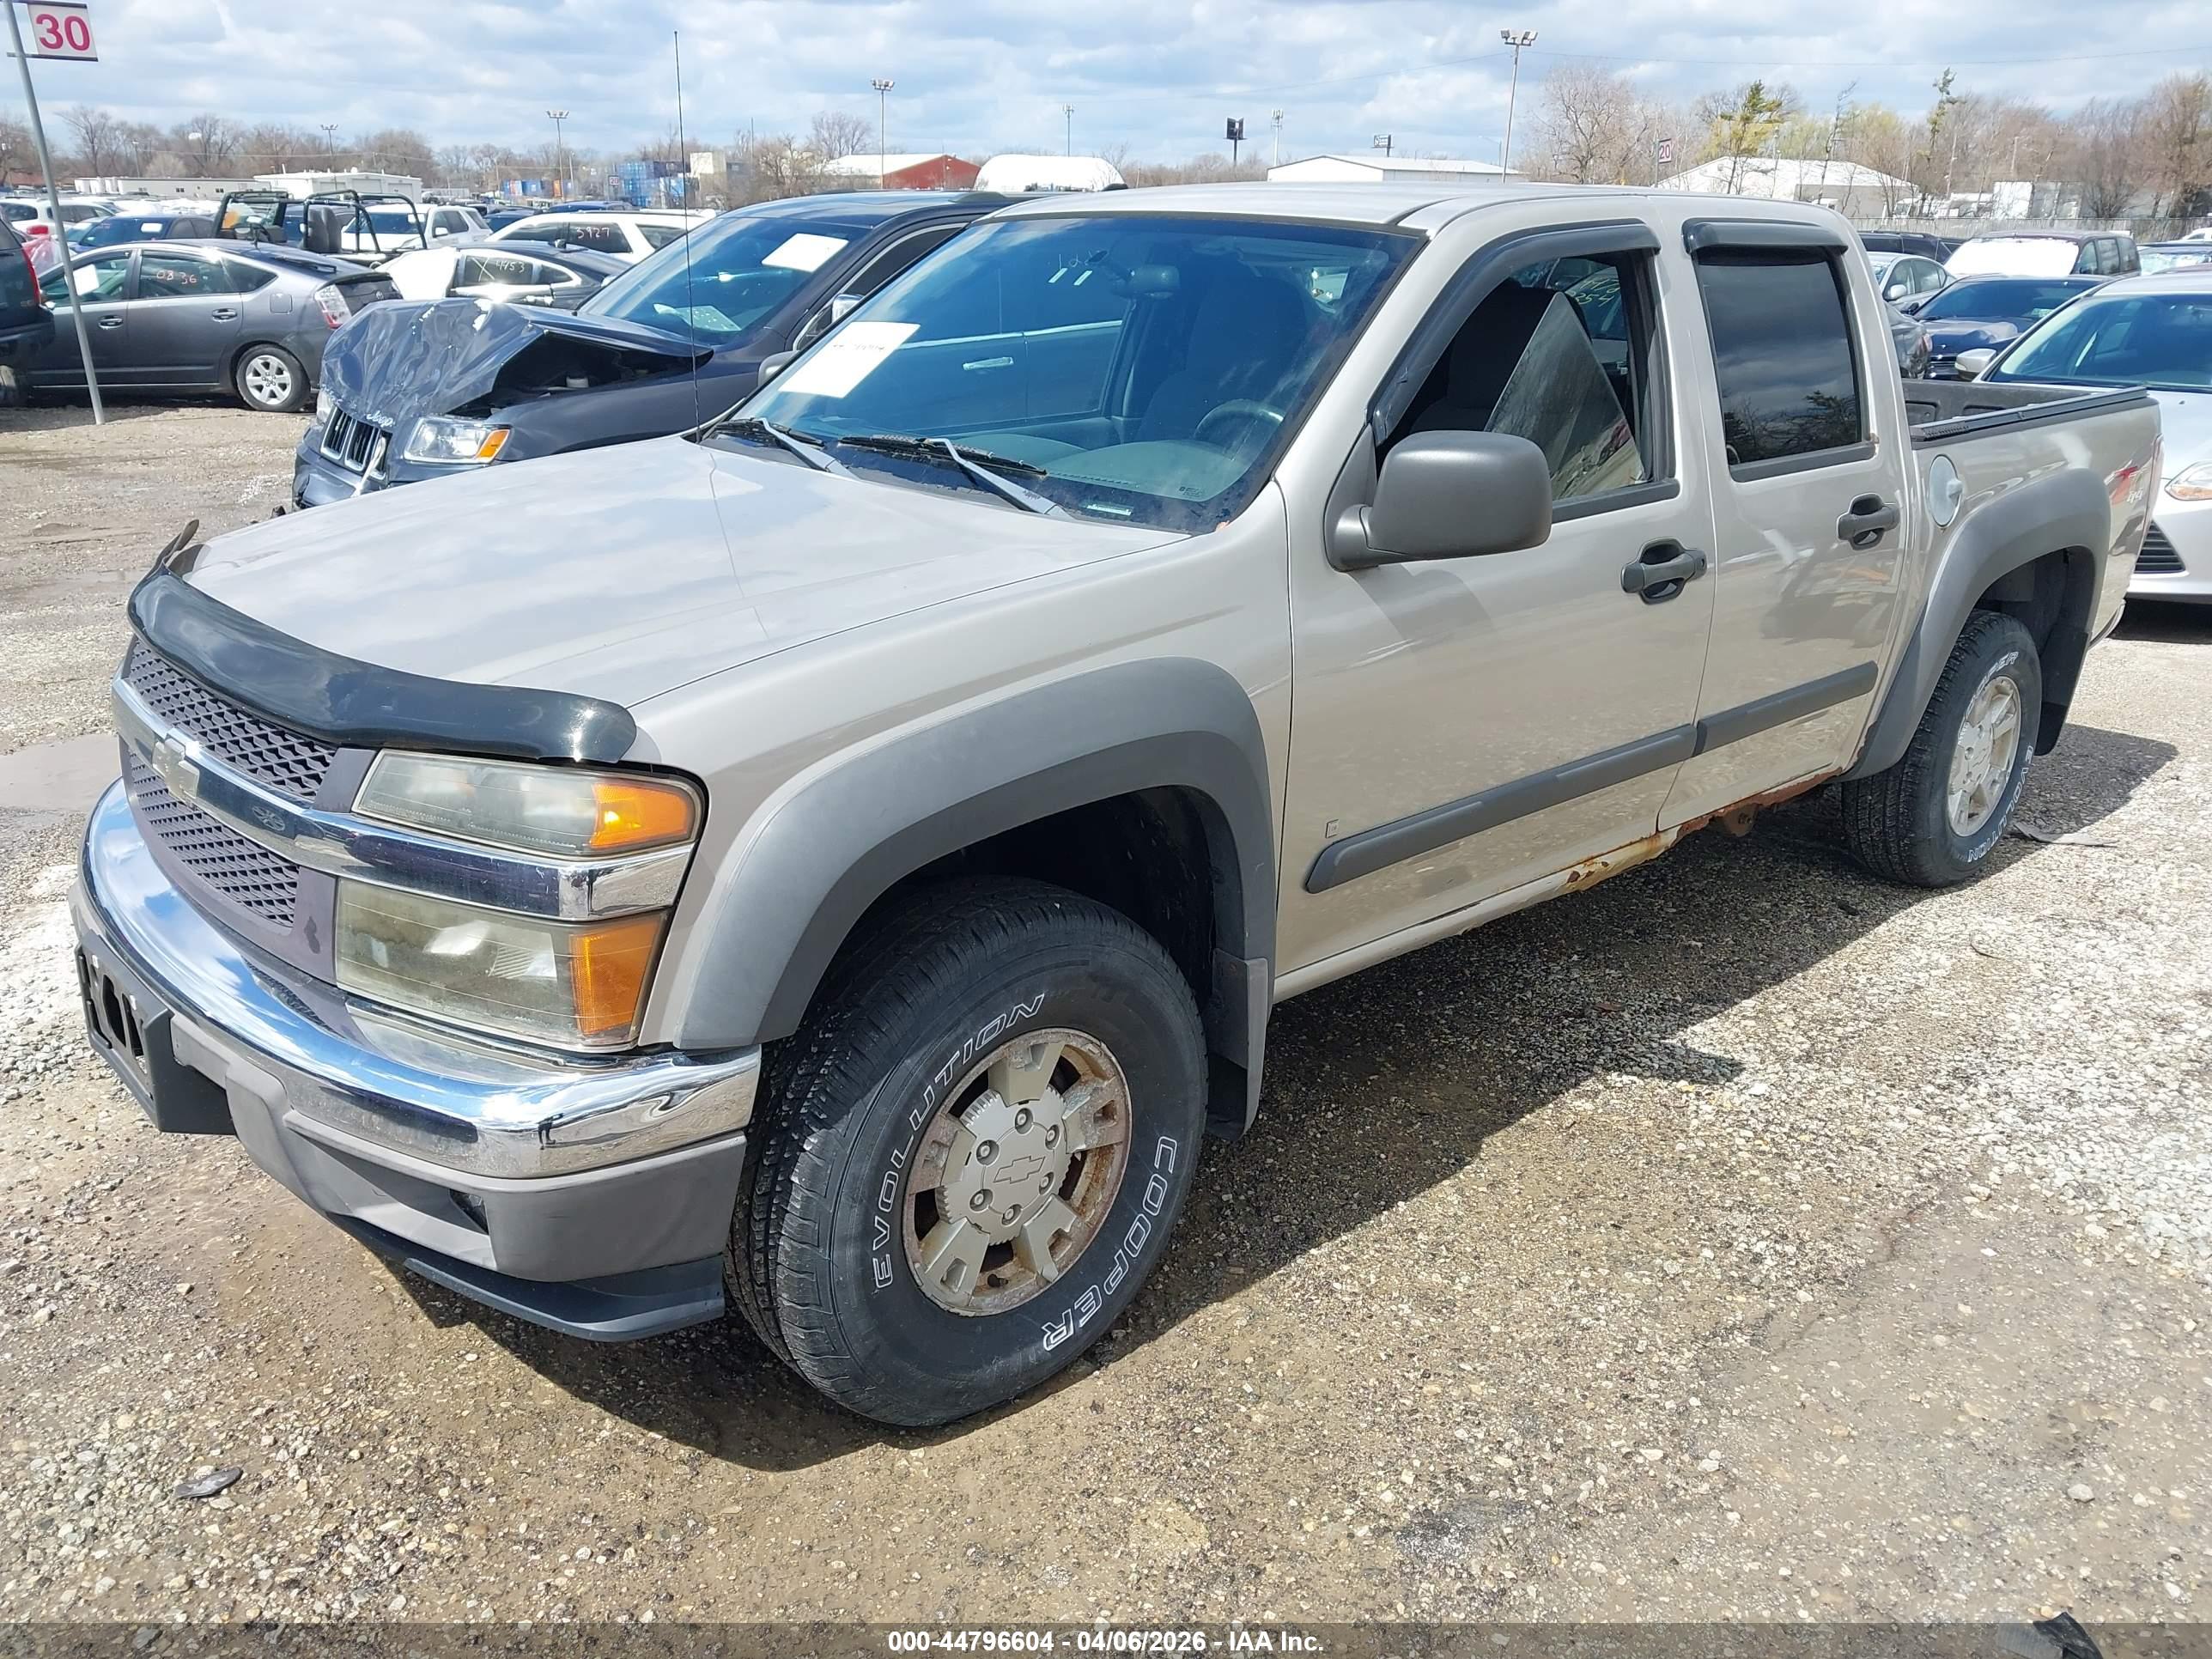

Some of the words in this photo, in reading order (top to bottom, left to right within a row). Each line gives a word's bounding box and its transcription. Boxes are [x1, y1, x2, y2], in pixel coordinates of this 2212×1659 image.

[36, 14, 90, 51] 30
[1658, 144, 1671, 159] 20
[1967, 744, 2034, 862] EVOLUTION
[872, 994, 1045, 1289] EVOLUTION
[1042, 1136, 1177, 1352] COOPER
